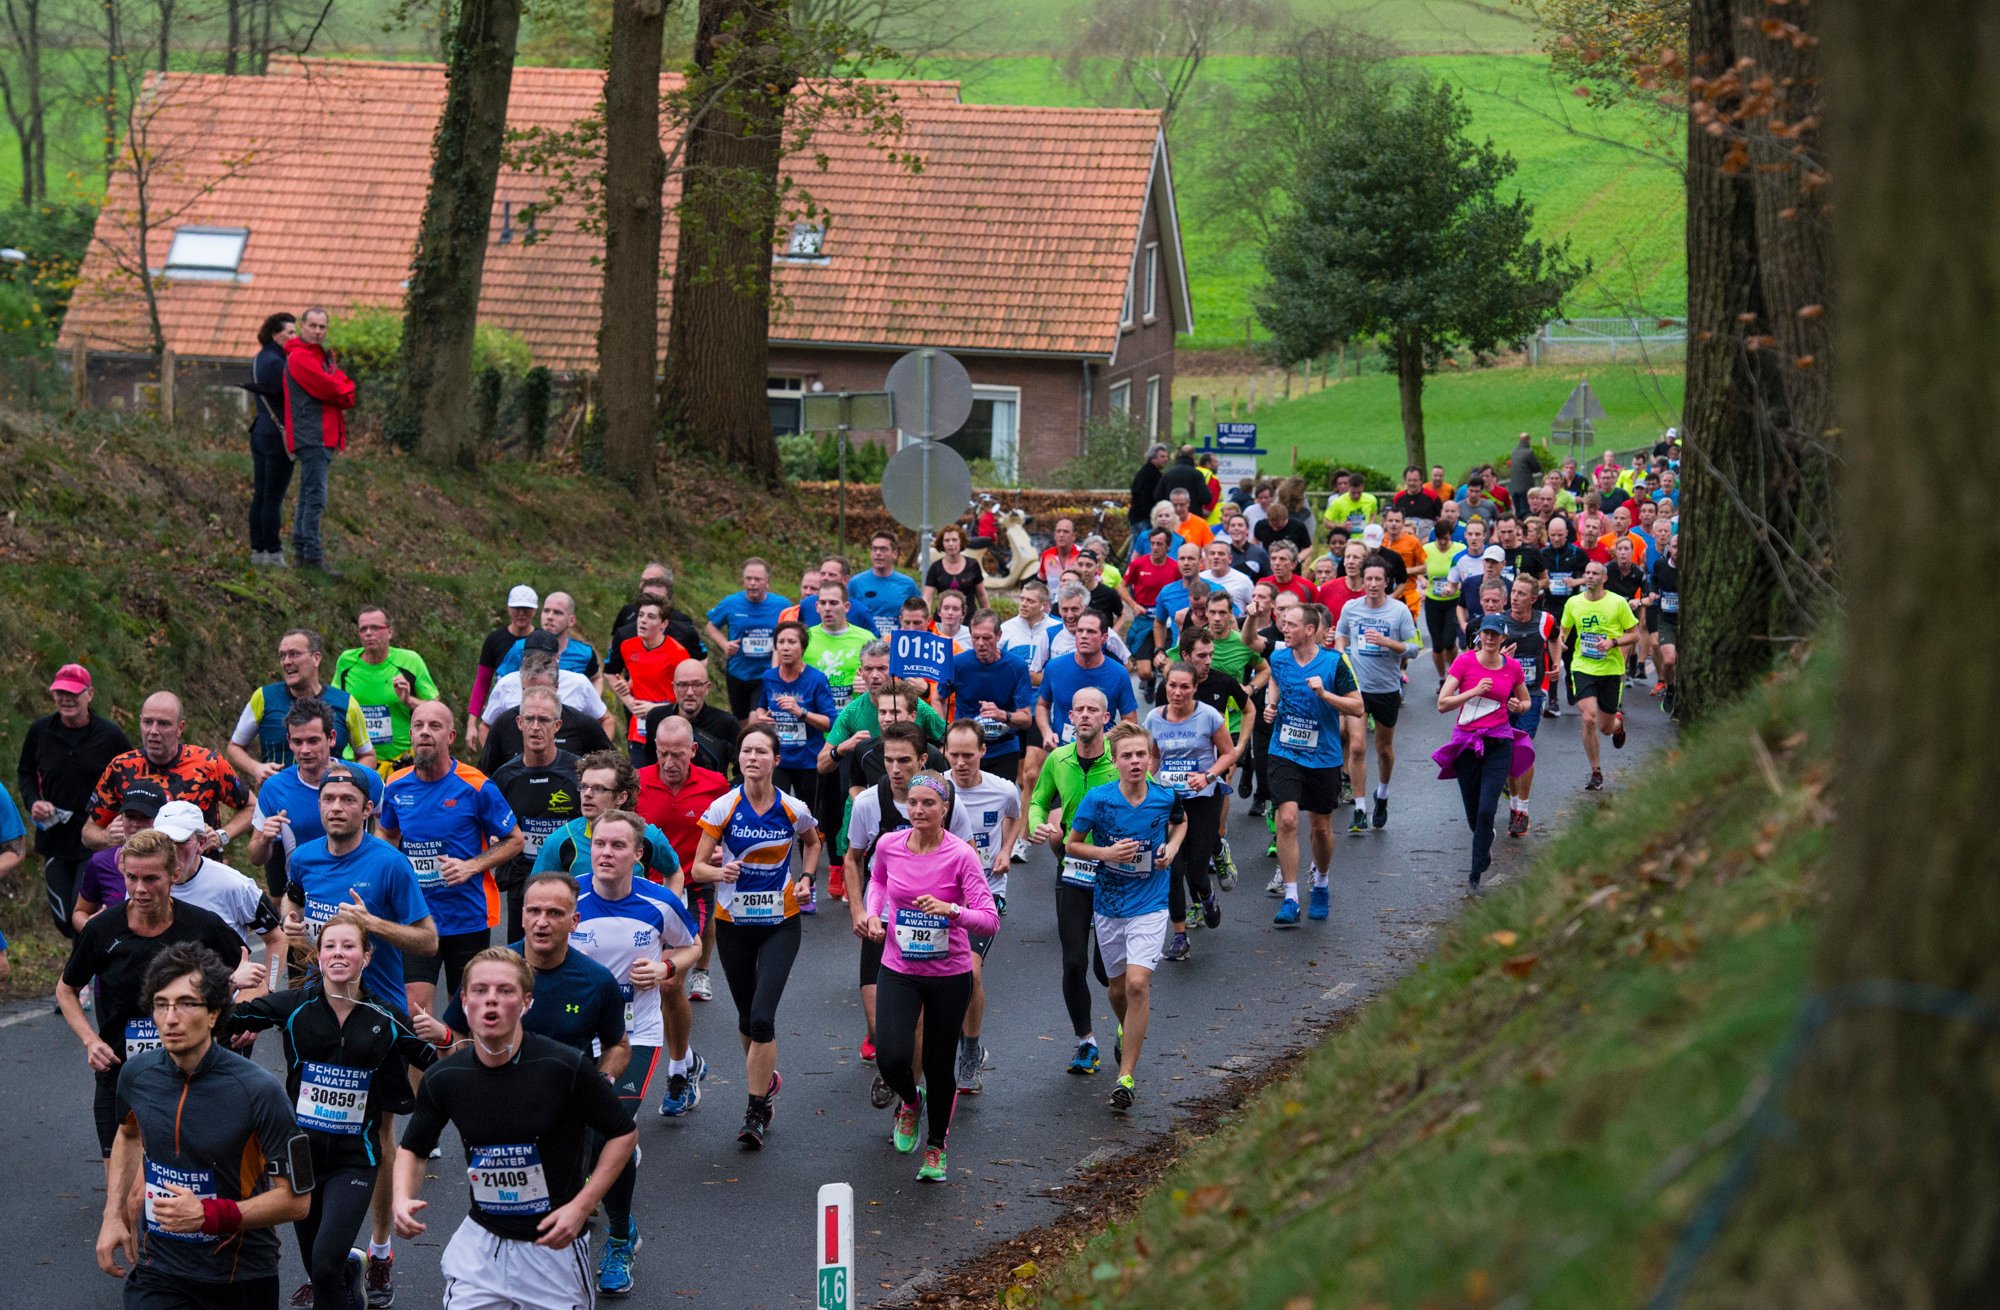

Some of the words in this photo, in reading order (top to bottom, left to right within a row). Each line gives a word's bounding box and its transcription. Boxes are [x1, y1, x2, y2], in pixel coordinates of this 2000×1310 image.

[1218, 424, 1229, 433] TE
[1231, 424, 1255, 434] KOOP
[898, 635, 945, 664] 01:15
[1287, 715, 1318, 725] SCHOLTEN
[1290, 721, 1313, 729] AWATER
[1178, 731, 1197, 739] PARK
[1288, 728, 1311, 739] 20357
[731, 825, 788, 840] Rabobank
[403, 841, 442, 849] SCHOLTEN
[414, 859, 434, 871] 1257
[743, 894, 774, 906] 26744
[905, 919, 940, 927] AWATER
[911, 930, 931, 941] 792
[308, 1063, 368, 1079] SCHOLTEN
[314, 1074, 359, 1088] AWATER
[310, 1087, 356, 1108] 30859
[314, 1104, 348, 1121] Manon
[474, 1146, 532, 1157] SCHOLTEN
[479, 1157, 527, 1167] AWATER
[151, 1162, 209, 1182] SCHOLTEN
[481, 1171, 528, 1188] 21409
[497, 1189, 519, 1203] Roy
